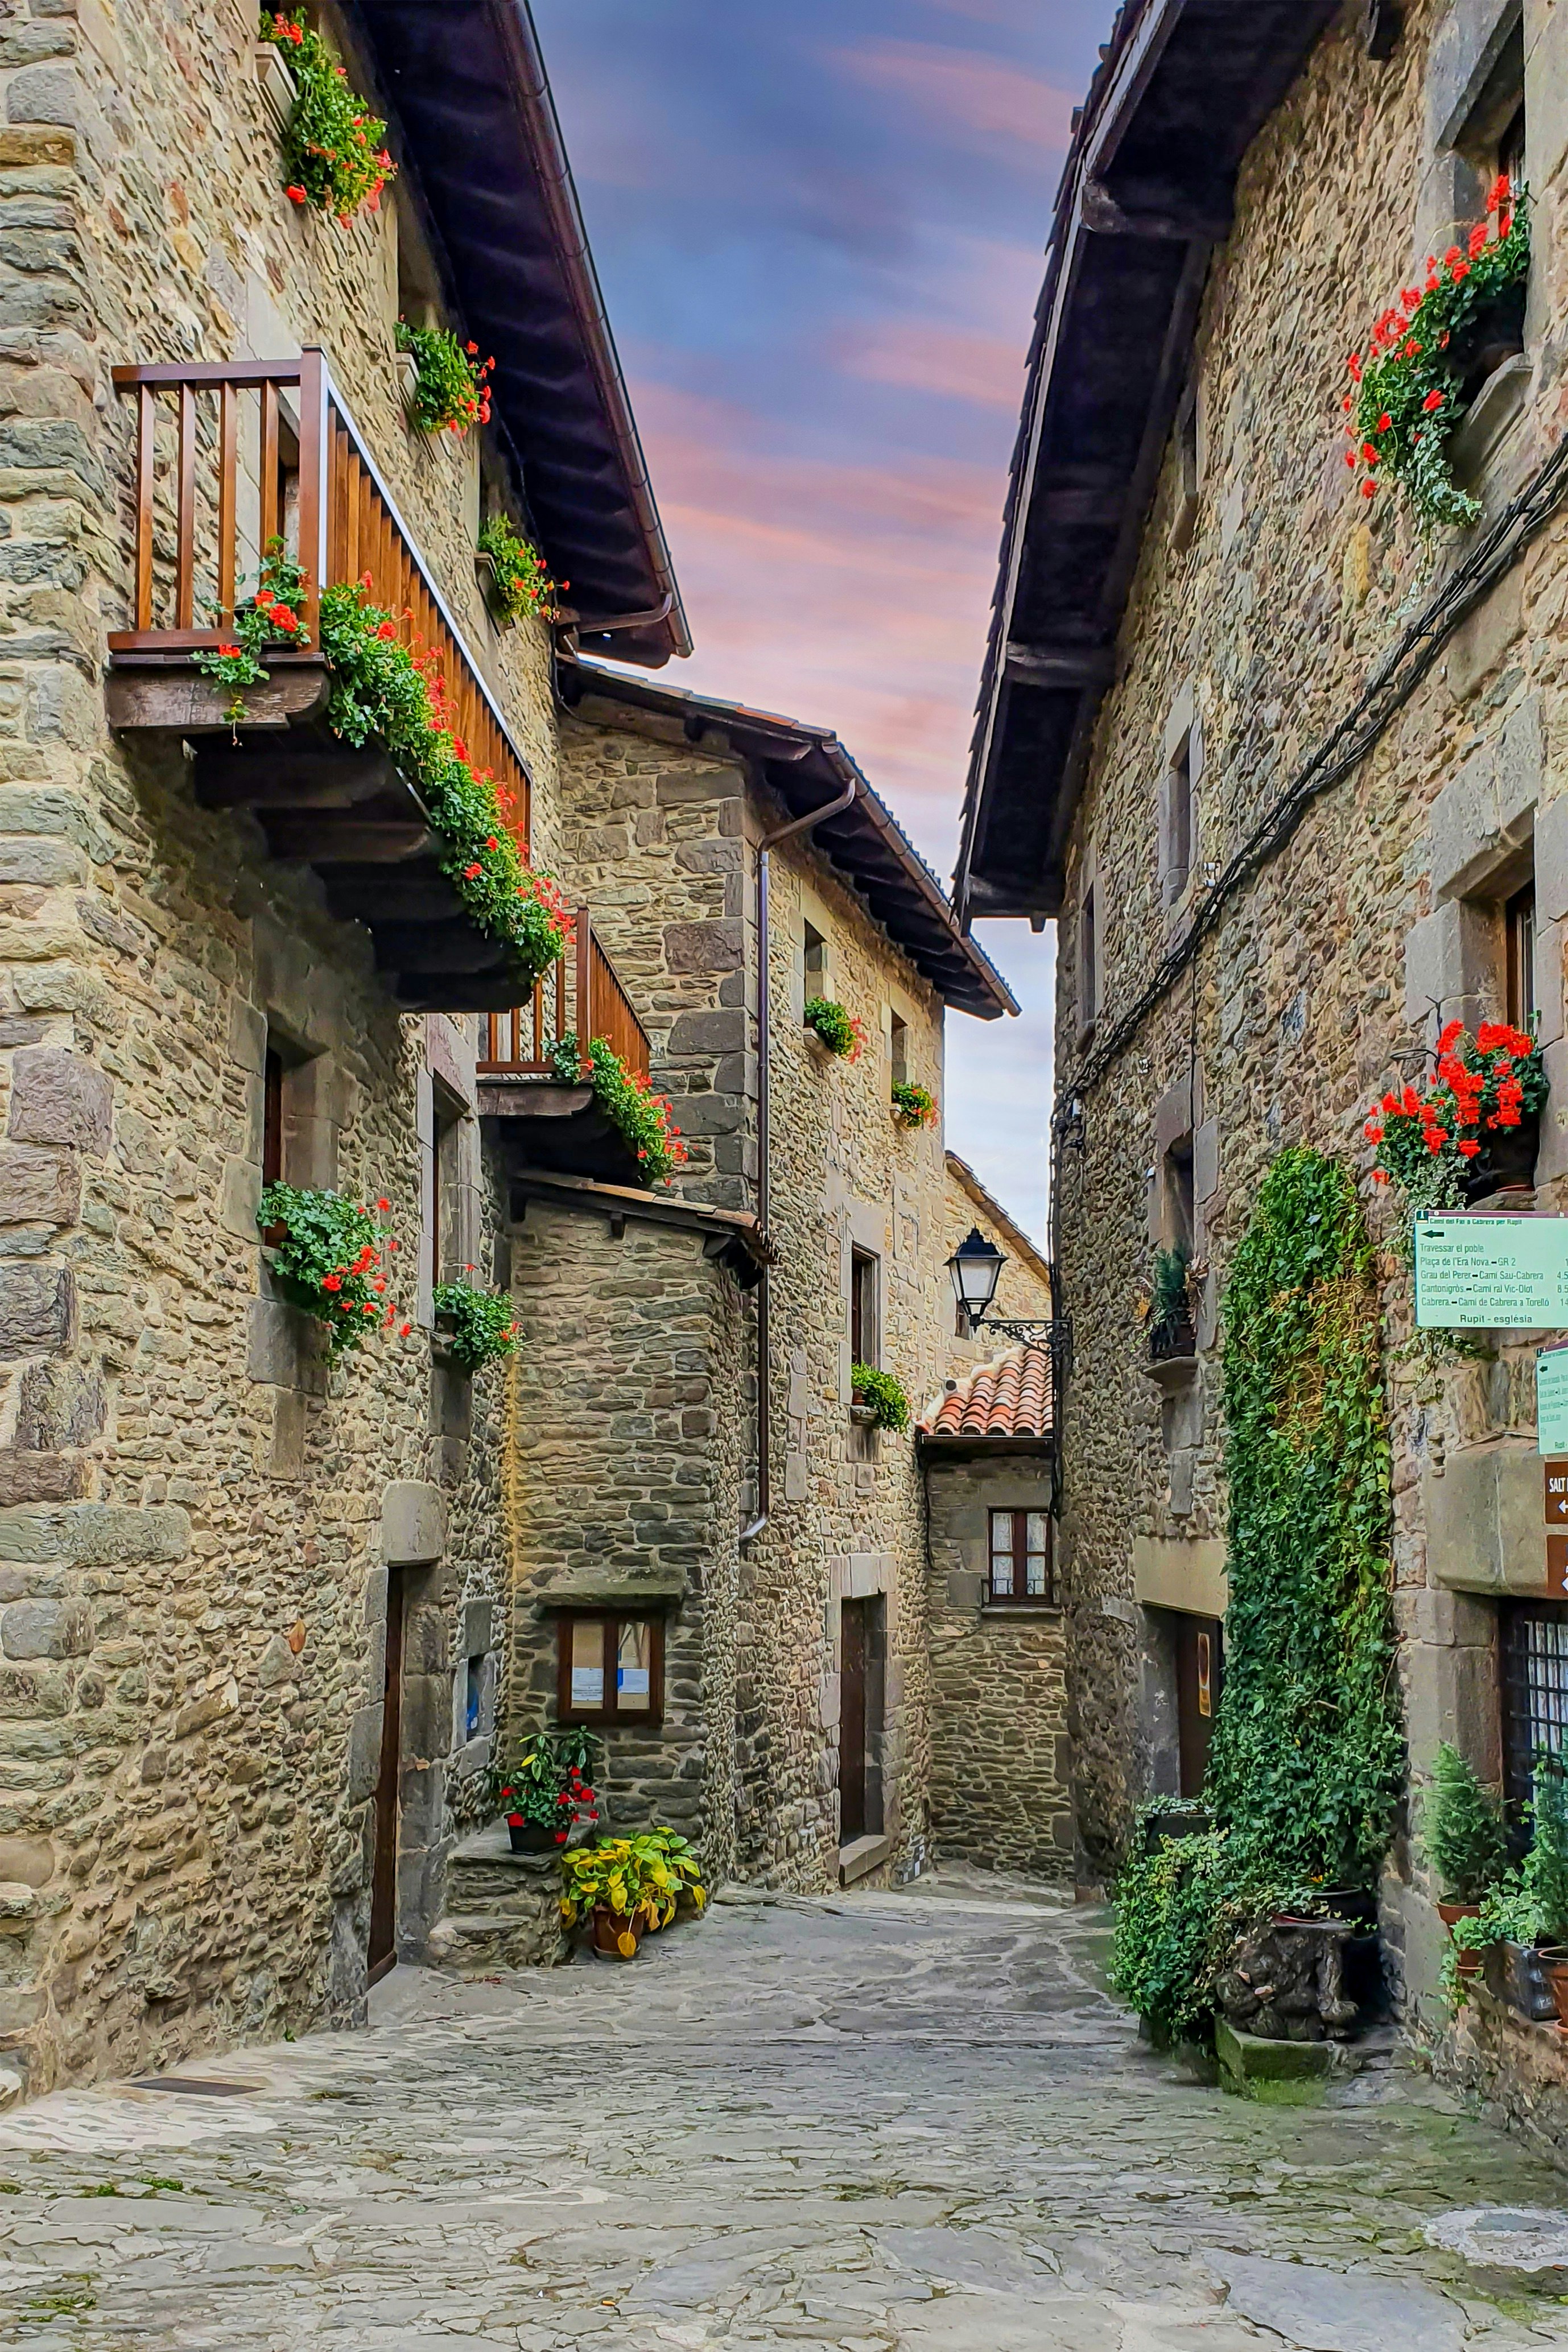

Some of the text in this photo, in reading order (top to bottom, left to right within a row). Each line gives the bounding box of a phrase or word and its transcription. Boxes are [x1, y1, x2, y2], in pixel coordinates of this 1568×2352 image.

[1420, 1243, 1484, 1254] Travessar el poble
[1420, 1257, 1439, 1268] Plaça
[1442, 1257, 1451, 1266] de
[1453, 1257, 1468, 1266] l'Era
[1511, 1257, 1516, 1266] 2
[1421, 1270, 1438, 1279] Grau
[1439, 1270, 1450, 1279] del
[1500, 1270, 1544, 1280] Sau-Cabrera
[1504, 1284, 1533, 1293] Vic-Olot
[1489, 1297, 1517, 1306] Cabrera
[1460, 1314, 1484, 1324] Rupit
[1493, 1314, 1532, 1324] església
[1549, 1477, 1566, 1493] SALT
